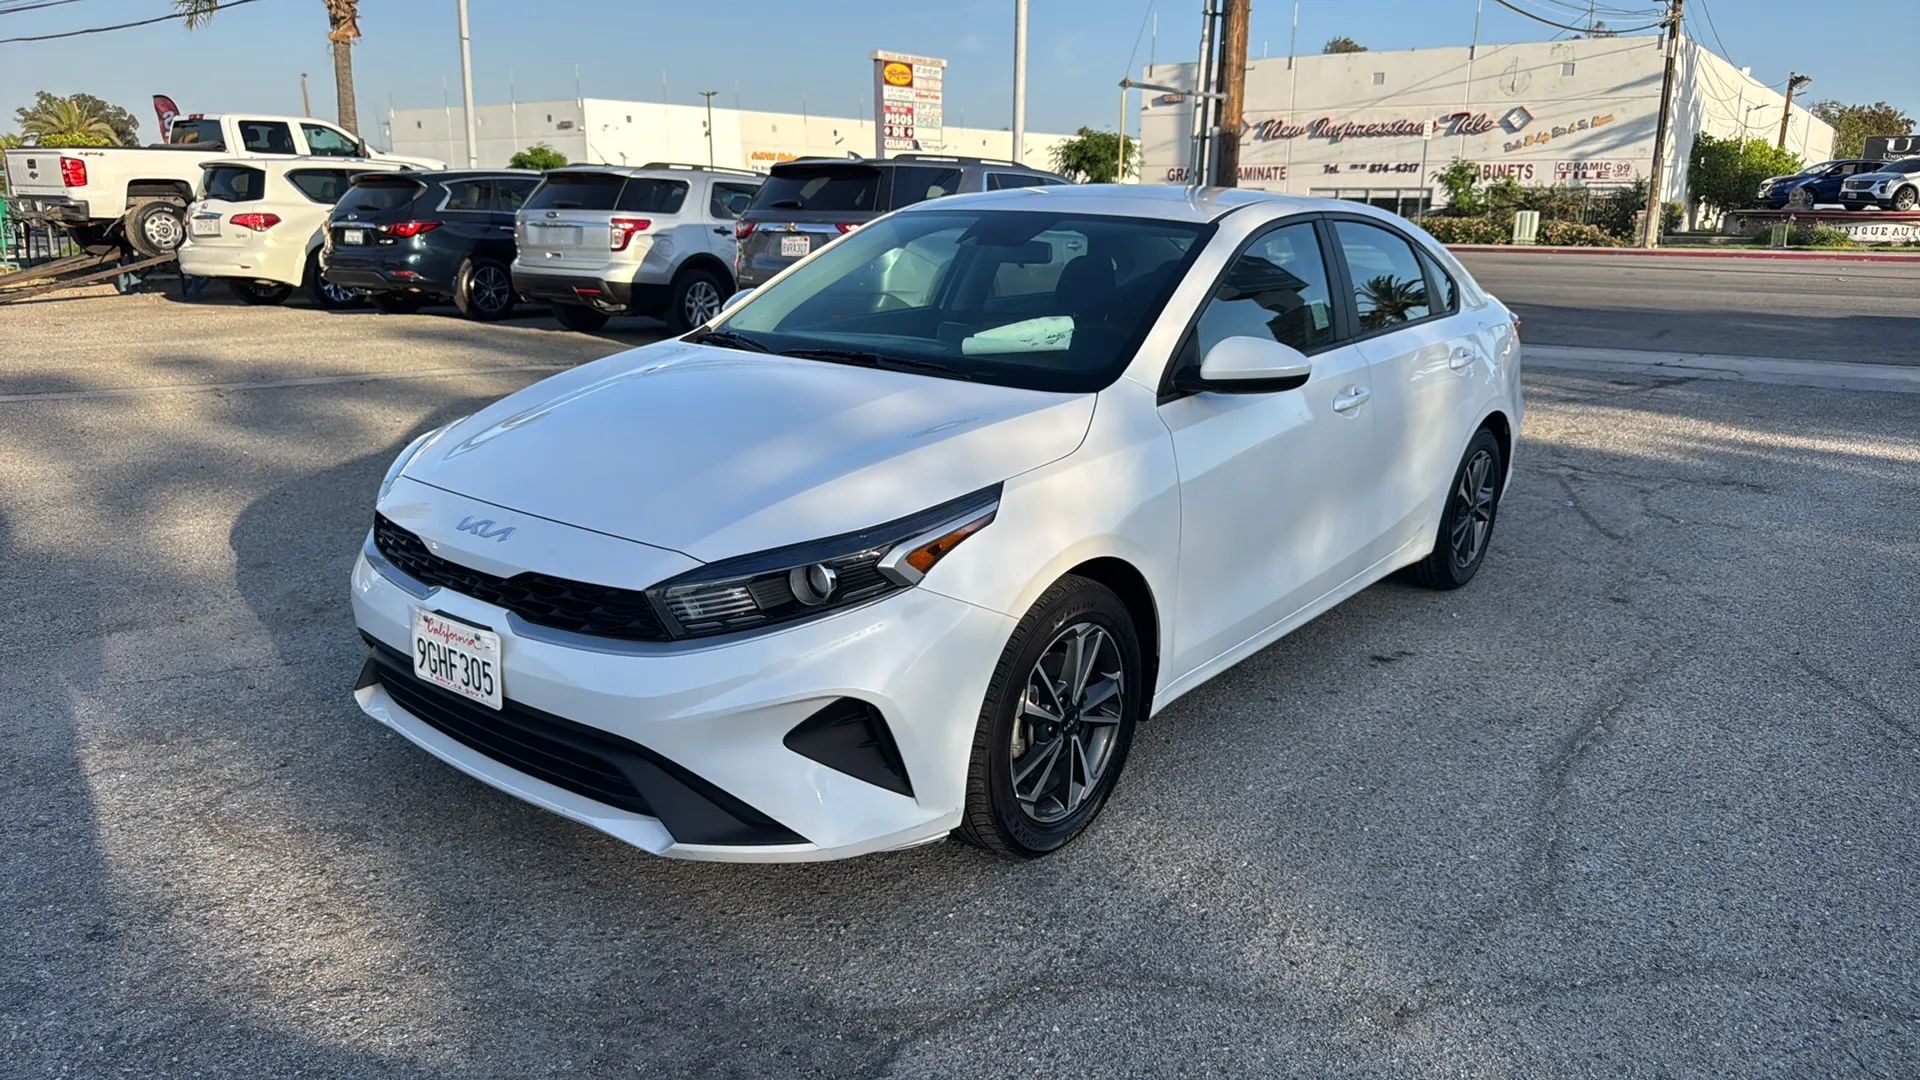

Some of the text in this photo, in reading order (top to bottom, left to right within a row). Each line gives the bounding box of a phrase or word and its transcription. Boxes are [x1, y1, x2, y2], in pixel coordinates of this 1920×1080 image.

[885, 112, 912, 126] PISOS
[1261, 118, 1306, 140] New
[1447, 112, 1495, 136] Tile
[892, 126, 905, 138] DE
[1885, 137, 1916, 153] U
[1368, 163, 1420, 174] 874-4317
[1475, 163, 1534, 182] ABINETS
[1557, 161, 1612, 171] CERAMIC
[1236, 166, 1287, 182] AMINATE
[1556, 171, 1610, 180] TILE
[1892, 226, 1920, 237] AUT
[427, 616, 480, 650] California
[417, 636, 495, 697] 9GHF305
